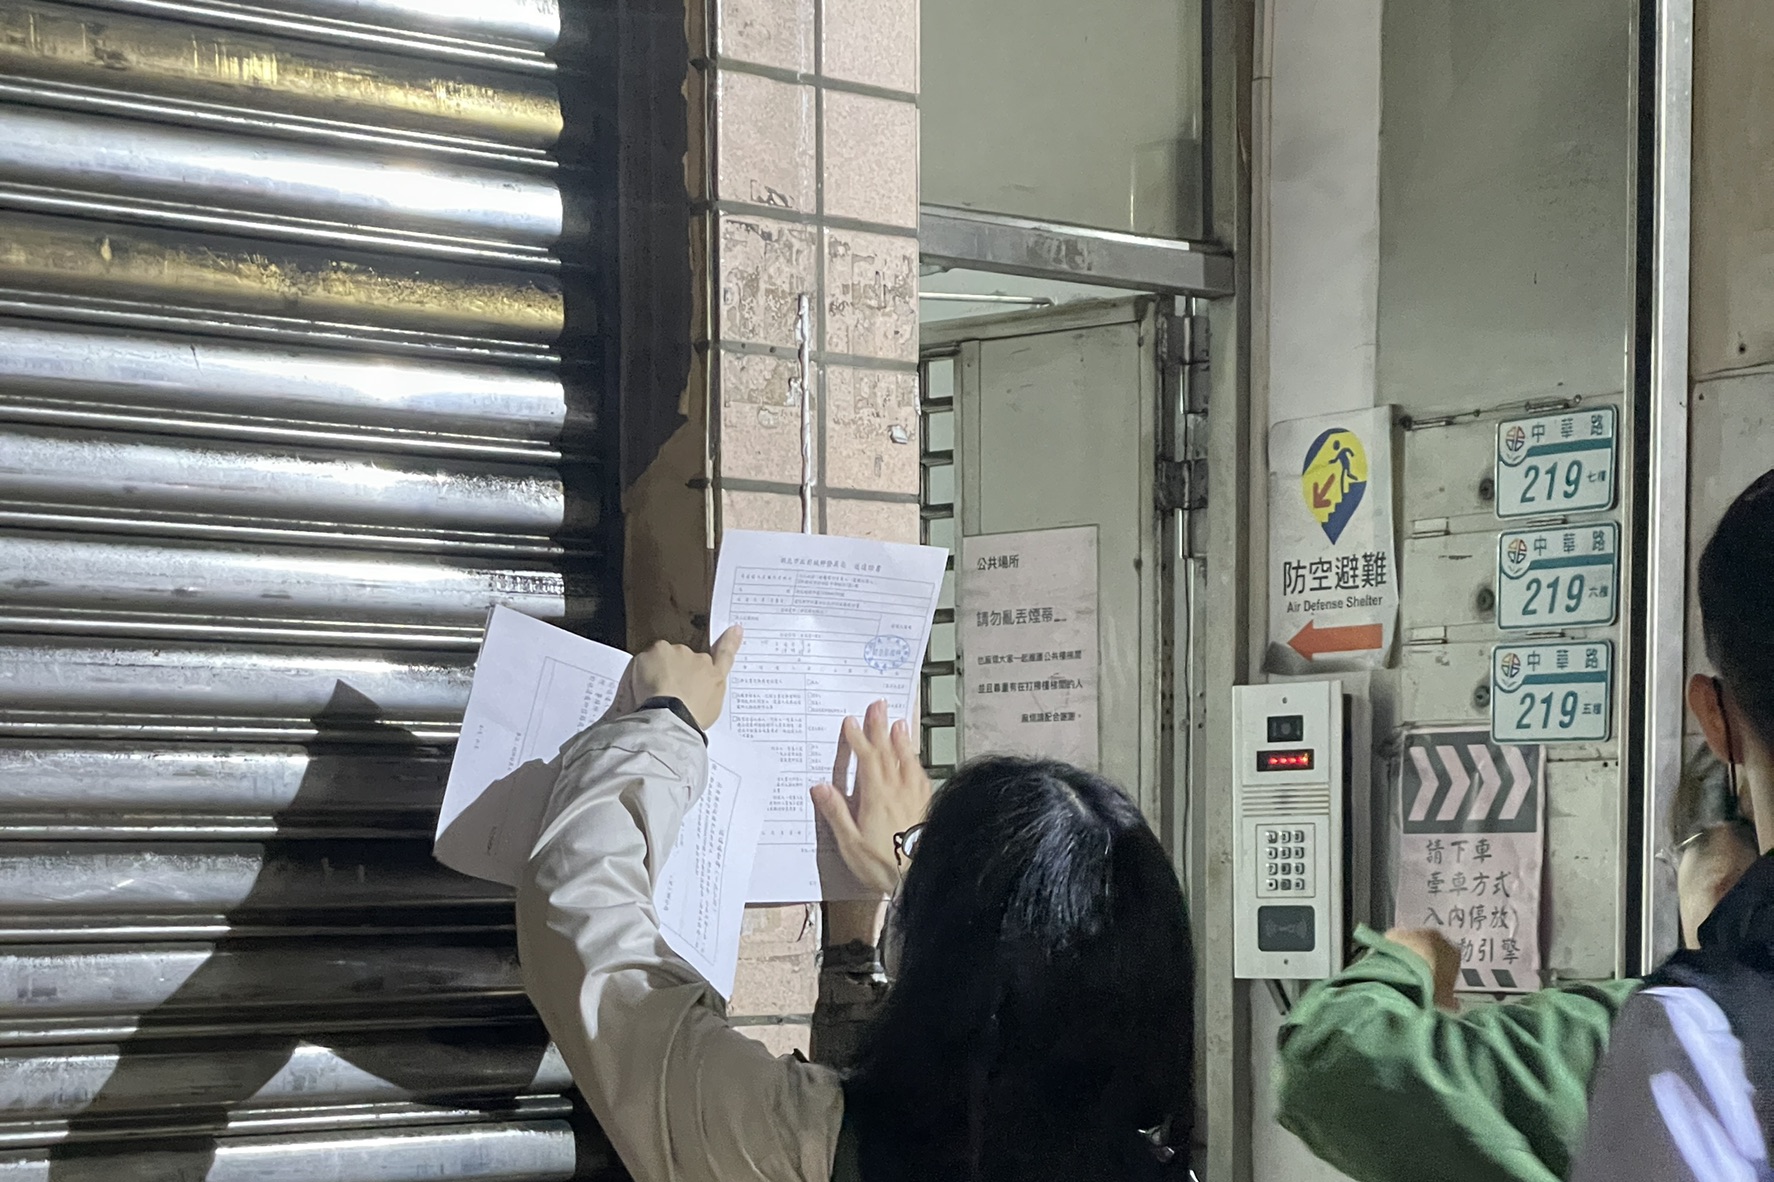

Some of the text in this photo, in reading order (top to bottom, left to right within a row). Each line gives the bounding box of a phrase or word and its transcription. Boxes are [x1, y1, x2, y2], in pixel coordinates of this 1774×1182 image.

[1532, 414, 1604, 443] 中華路
[1520, 460, 1582, 503] 219
[1533, 530, 1606, 556] 中華路
[977, 554, 1020, 571] 公共場所
[1283, 551, 1387, 596] 防空避難
[1287, 594, 1383, 613] Air Defense Shelter
[1521, 573, 1585, 616] 219
[1527, 648, 1599, 672] 中華路
[1516, 690, 1579, 729] 219
[1425, 839, 1493, 864] 請下車
[1423, 904, 1509, 931] 入內停放
